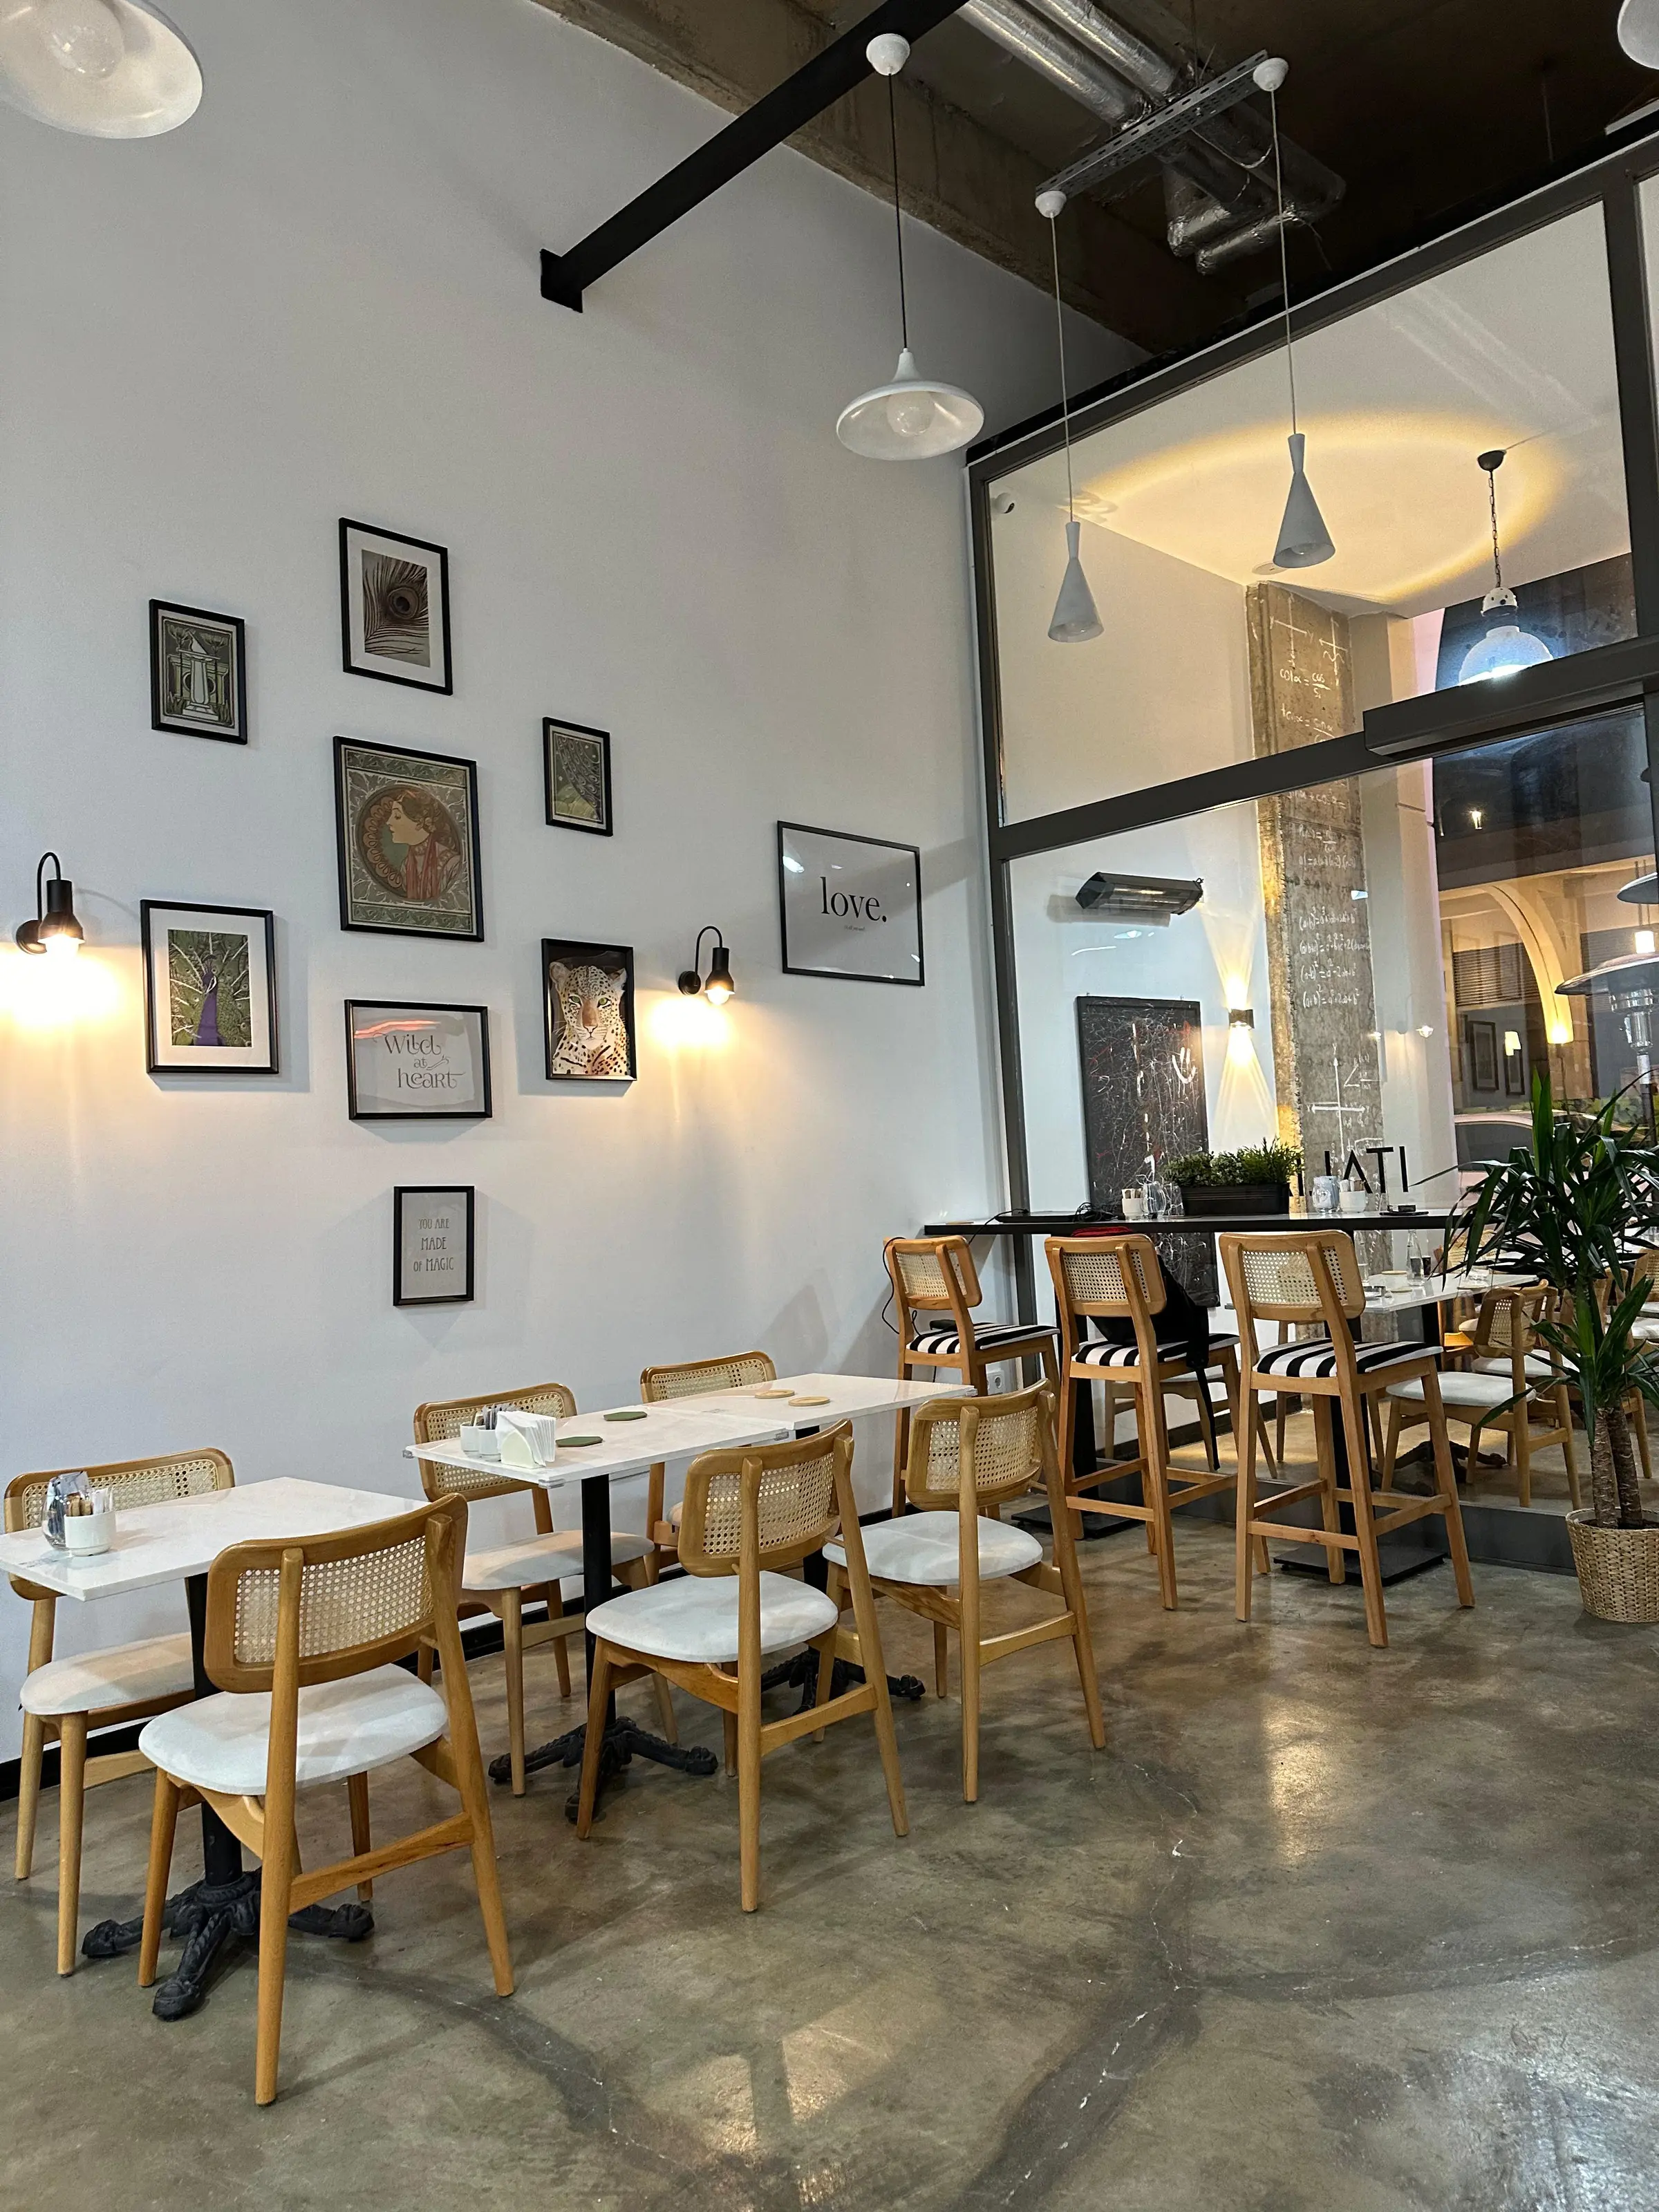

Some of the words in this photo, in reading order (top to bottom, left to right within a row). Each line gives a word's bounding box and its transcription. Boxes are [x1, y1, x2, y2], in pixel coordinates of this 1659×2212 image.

[820, 877, 887, 922] love.
[374, 1032, 441, 1056] Wild
[413, 1057, 428, 1069] at
[397, 1068, 465, 1089] heart
[419, 1218, 433, 1230] YOU
[435, 1218, 449, 1229] ARE
[421, 1237, 447, 1250] MADE
[413, 1260, 422, 1272] OF
[426, 1257, 454, 1272] MAGIC
